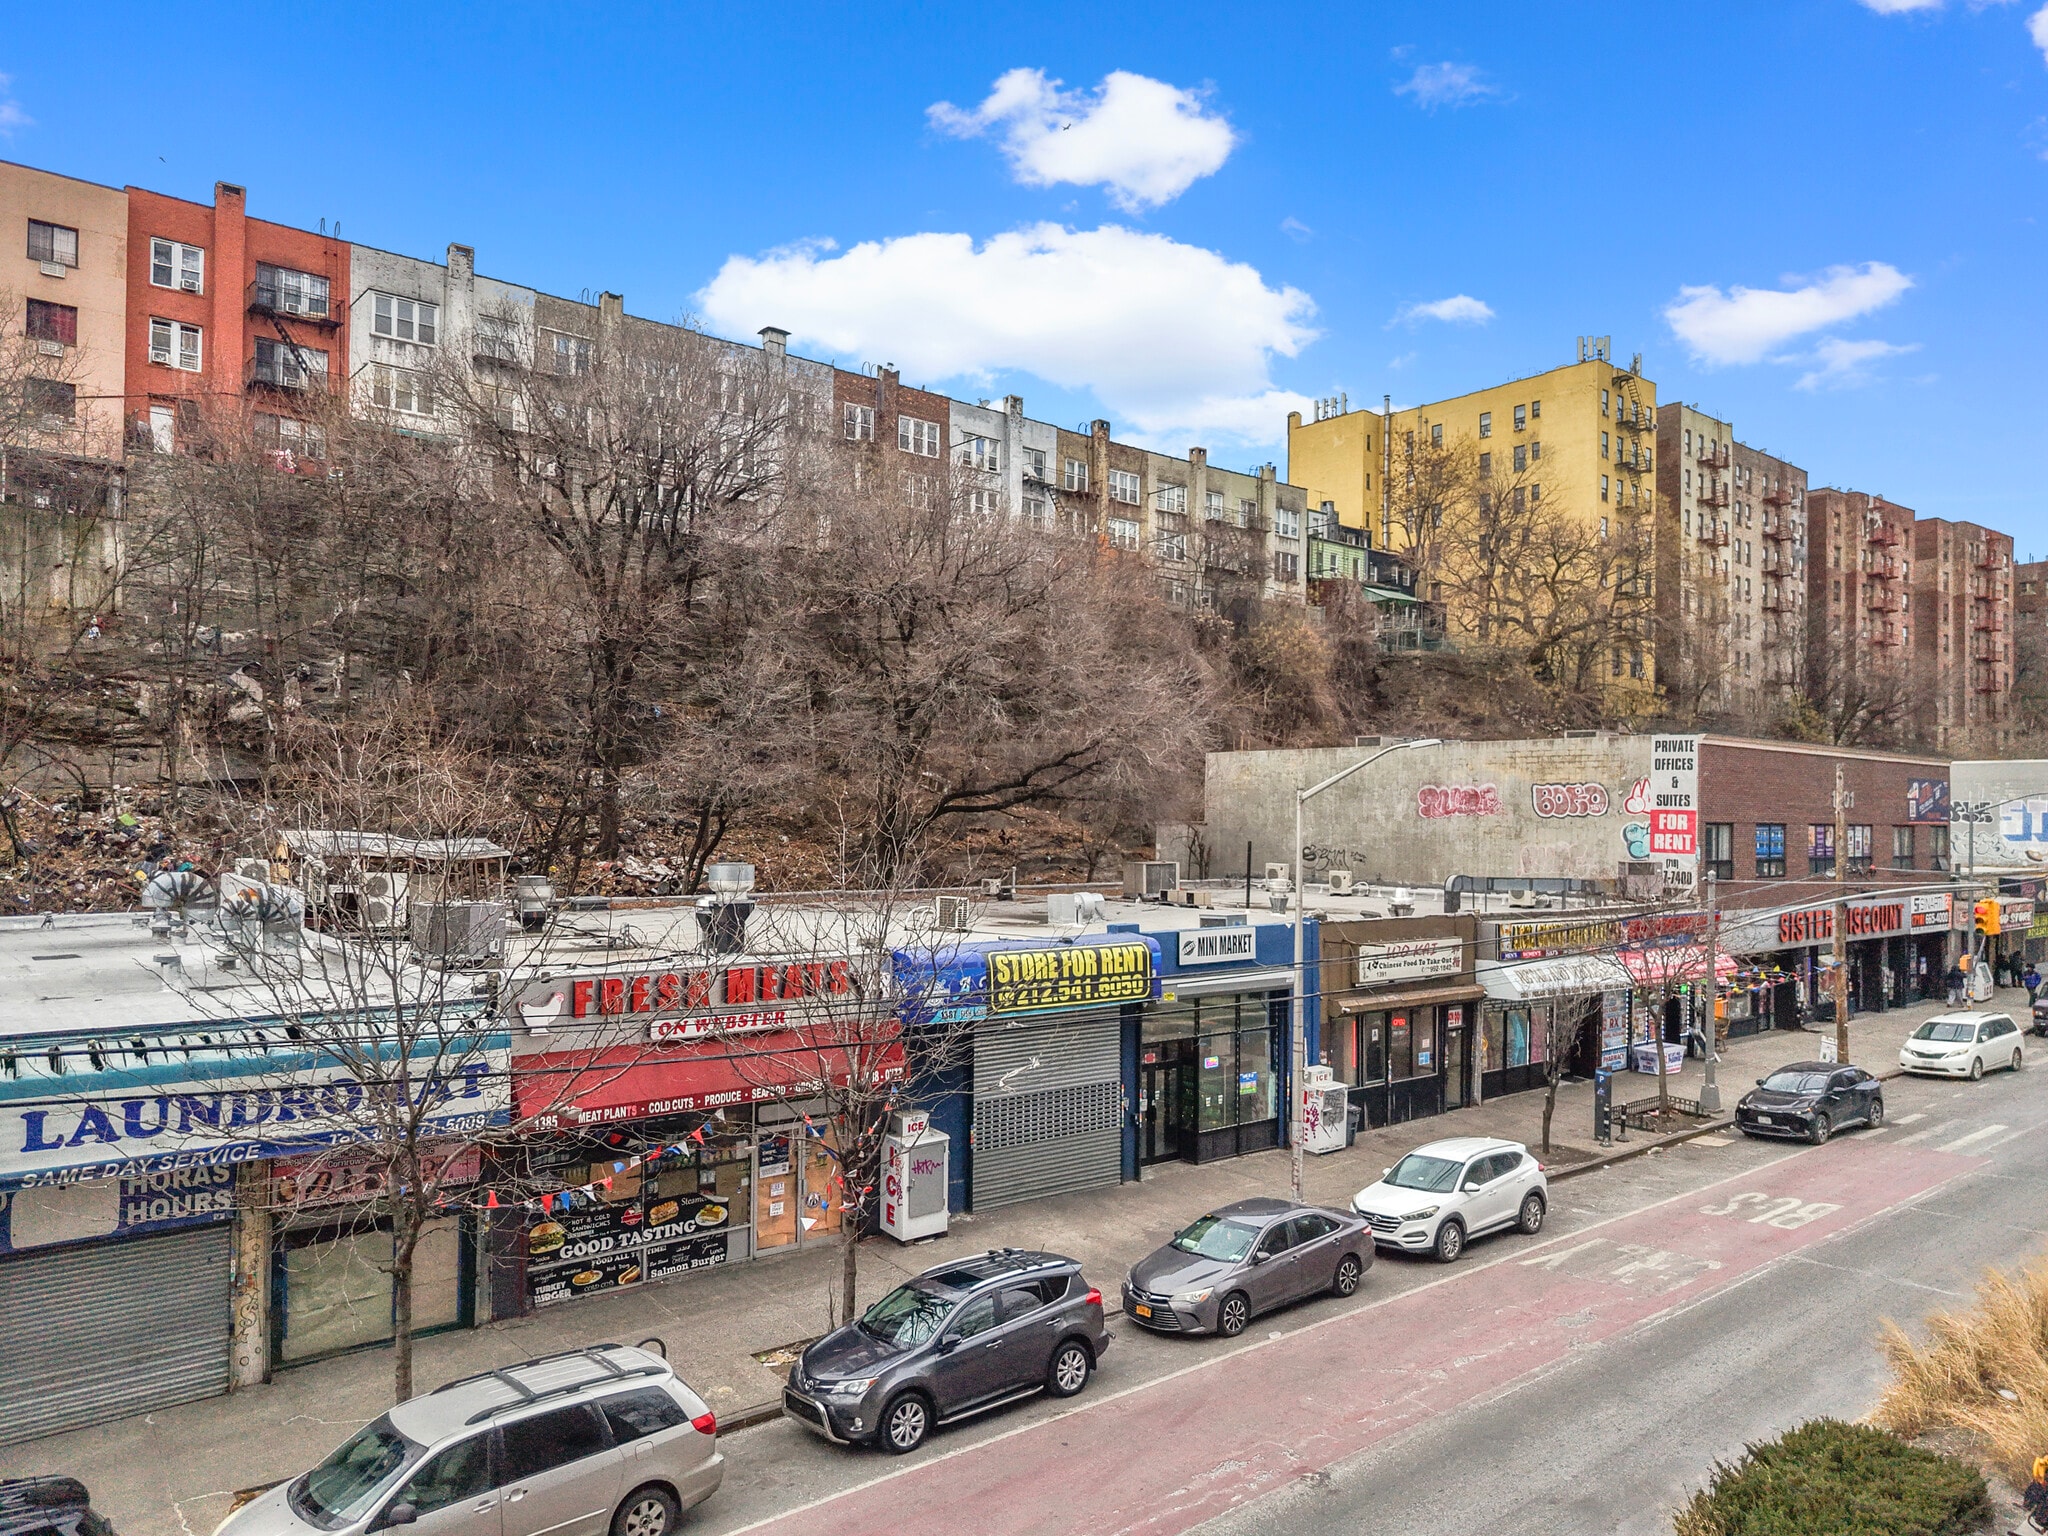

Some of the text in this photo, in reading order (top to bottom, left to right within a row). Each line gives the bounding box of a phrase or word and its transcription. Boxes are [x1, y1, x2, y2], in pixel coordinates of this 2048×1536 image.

[1655, 740, 1694, 752] PRIVATE
[1655, 758, 1693, 770] OFFICES
[1672, 776, 1678, 788] &
[1656, 794, 1690, 807] SUITES
[1832, 790, 1854, 808] 101
[1659, 813, 1688, 830] FOR
[1654, 833, 1692, 850] RENT
[1779, 909, 1833, 943] SISTER
[1845, 903, 1905, 935] ISCOUNT
[1198, 935, 1217, 957] MINI
[1220, 933, 1252, 955] MARKET
[995, 945, 1146, 984] STORE FOR RENT
[1379, 960, 1402, 970] Chinese
[1403, 959, 1418, 967] Food
[1419, 958, 1425, 966] To
[1427, 957, 1440, 965] Take
[572, 960, 848, 1019] FRESH MEATS
[657, 1010, 786, 1036] ON WEBSTER
[20, 1062, 489, 1153] LAUNDROAT
[534, 1115, 558, 1131] 1385
[578, 1109, 603, 1124] MEAT
[604, 1104, 638, 1120] PLANTS
[648, 1100, 671, 1114] COLD
[672, 1097, 694, 1111] CUTS
[704, 1087, 742, 1107] PRODUCE
[751, 1083, 786, 1099] SEAFOOD
[907, 1121, 925, 1133] ICE
[20, 1164, 96, 1188] SAME
[102, 1158, 154, 1179] DAY
[158, 1144, 260, 1171] SERVICE
[126, 1163, 232, 1196] HORAS
[885, 1146, 896, 1227] ICE
[126, 1189, 232, 1226] HOURS
[1699, 1191, 1845, 1231] BUS
[560, 1219, 697, 1259] GOOD TASTING
[614, 1253, 630, 1261] ALL
[650, 1263, 689, 1278] Salmon
[690, 1253, 726, 1268] Burger
[535, 1281, 567, 1295] TURKEY
